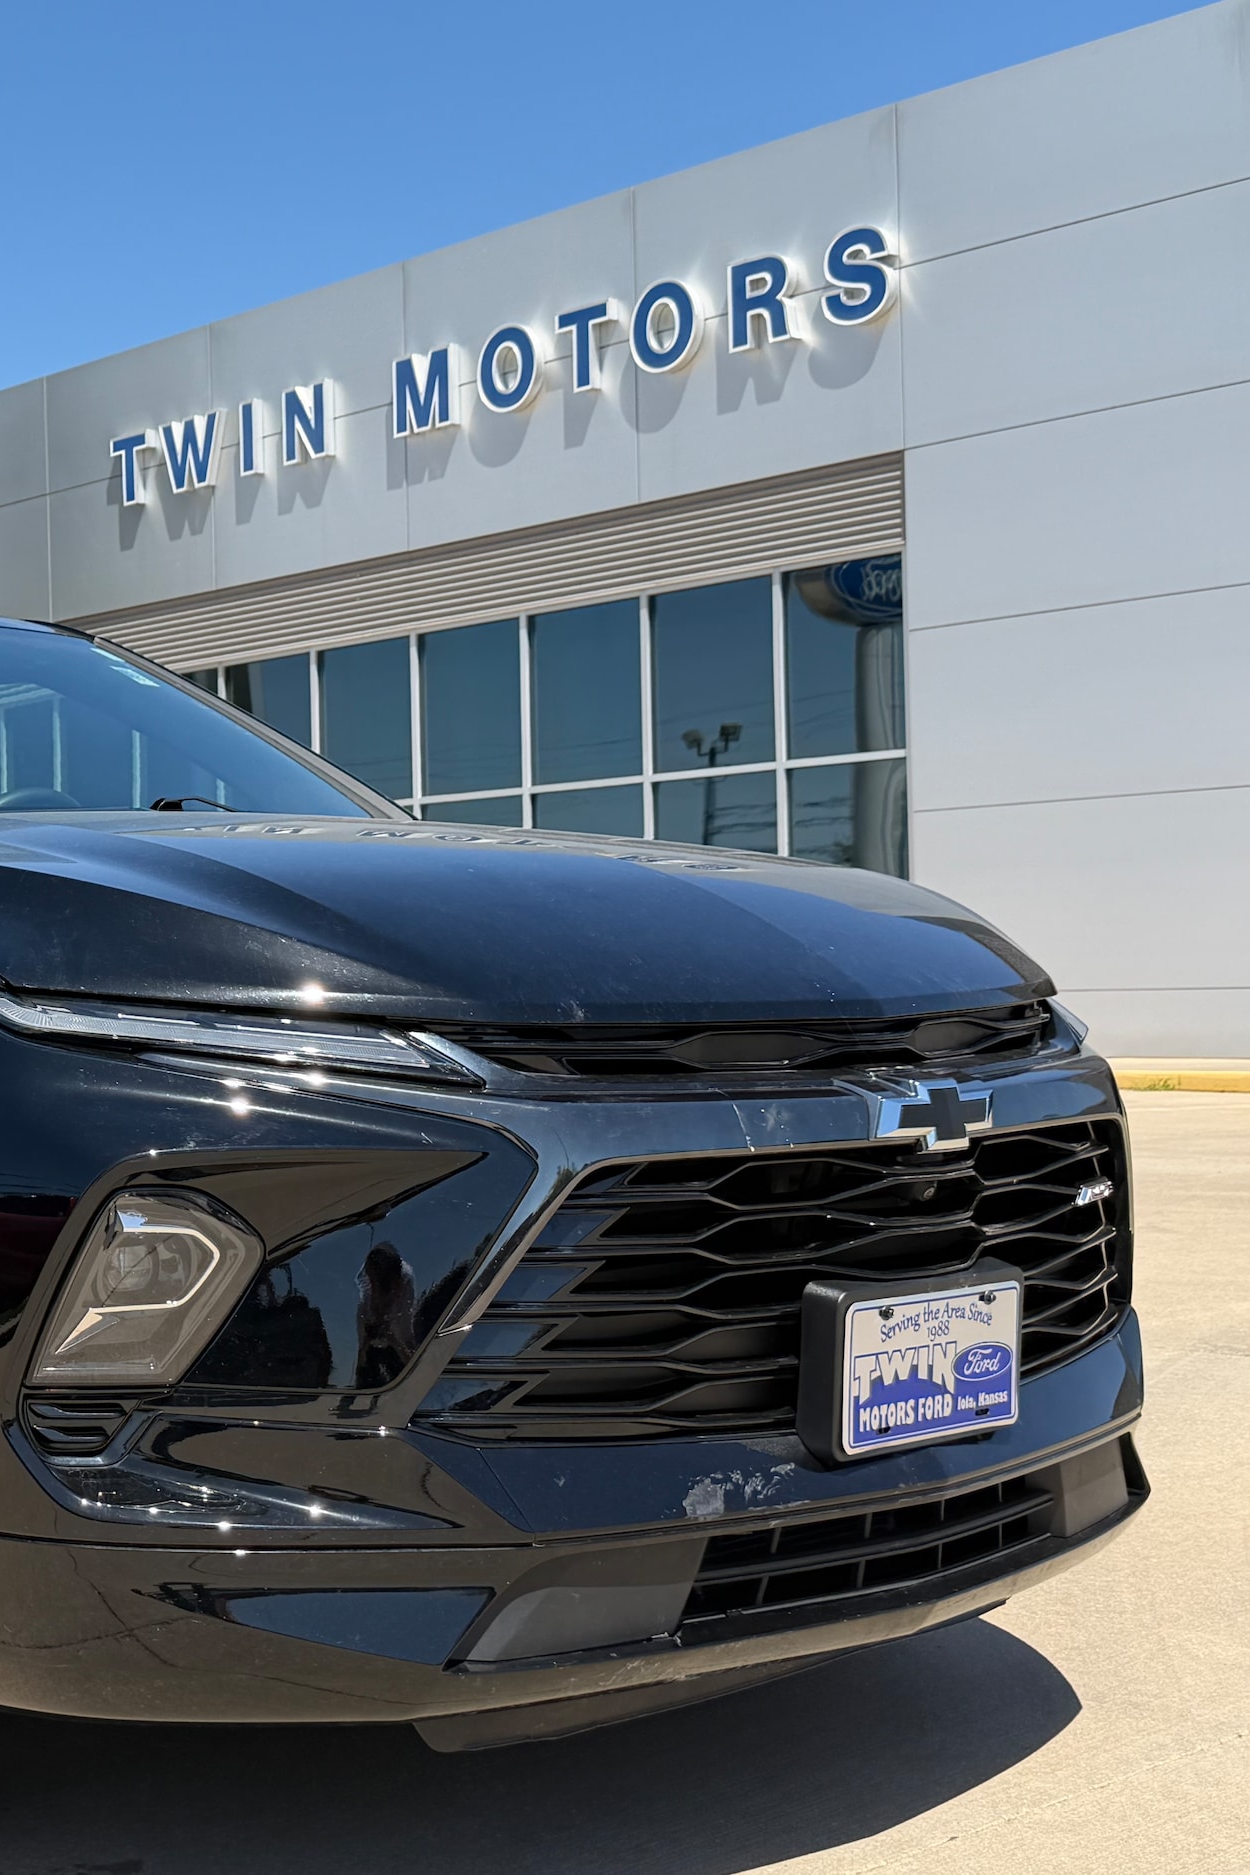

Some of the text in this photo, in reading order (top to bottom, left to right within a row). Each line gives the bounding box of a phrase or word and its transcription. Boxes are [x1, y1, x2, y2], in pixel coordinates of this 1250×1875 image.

[110, 225, 899, 506] TWIN MOTORS
[880, 1302, 993, 1343] Serving the Area Since
[926, 1319, 950, 1342] 1988
[853, 1341, 958, 1405] TWIN
[963, 1348, 1001, 1375] Ford
[859, 1393, 952, 1433] MOTORS FORD
[957, 1390, 1008, 1411] Iola, Kansas
